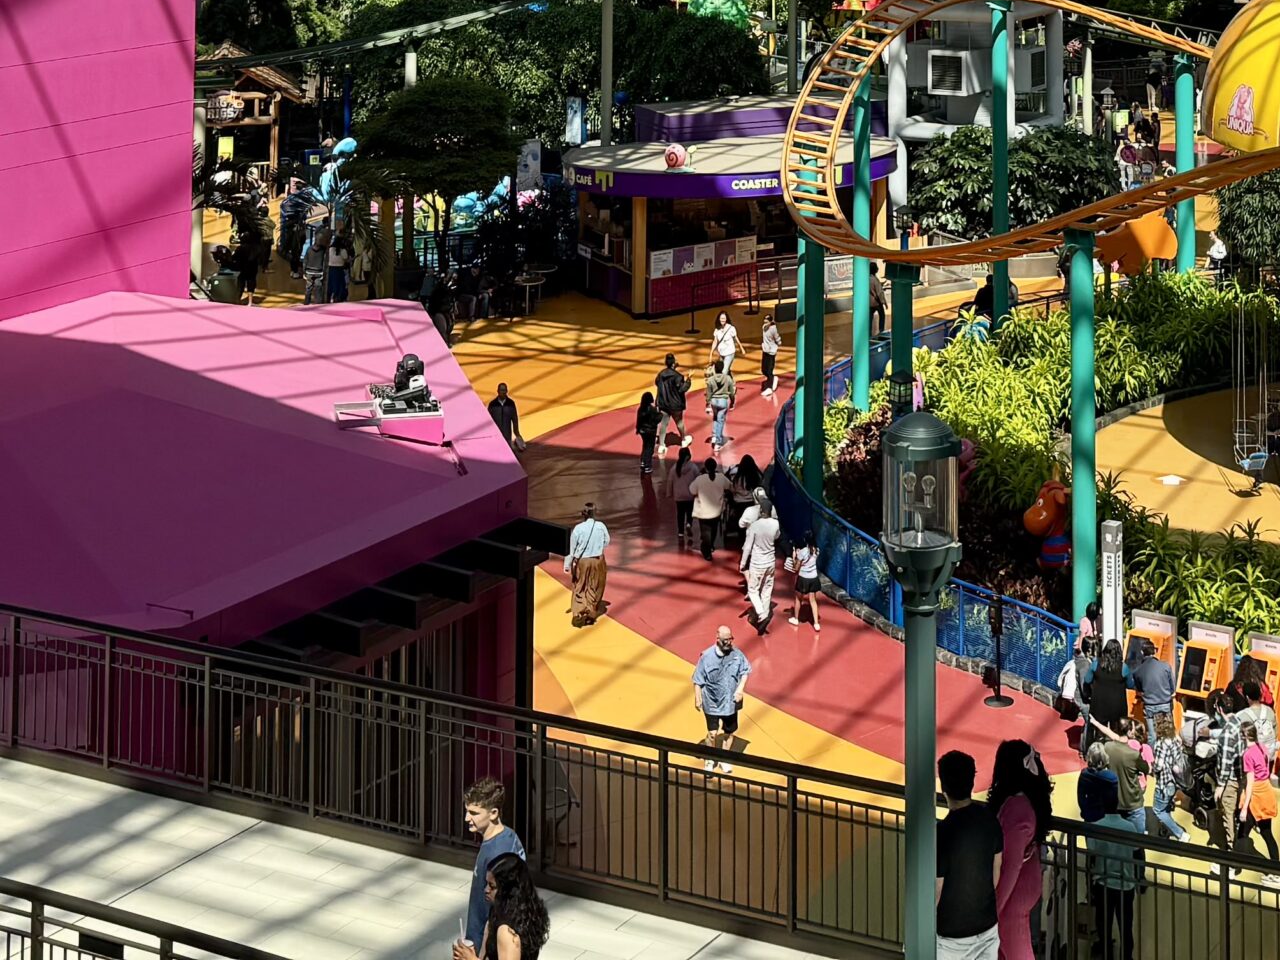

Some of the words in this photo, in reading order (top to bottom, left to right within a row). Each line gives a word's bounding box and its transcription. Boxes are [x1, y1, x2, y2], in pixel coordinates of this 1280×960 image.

[1226, 114, 1254, 136] UNIQUA
[576, 174, 592, 186] CAFÉ
[731, 178, 779, 190] COASTER
